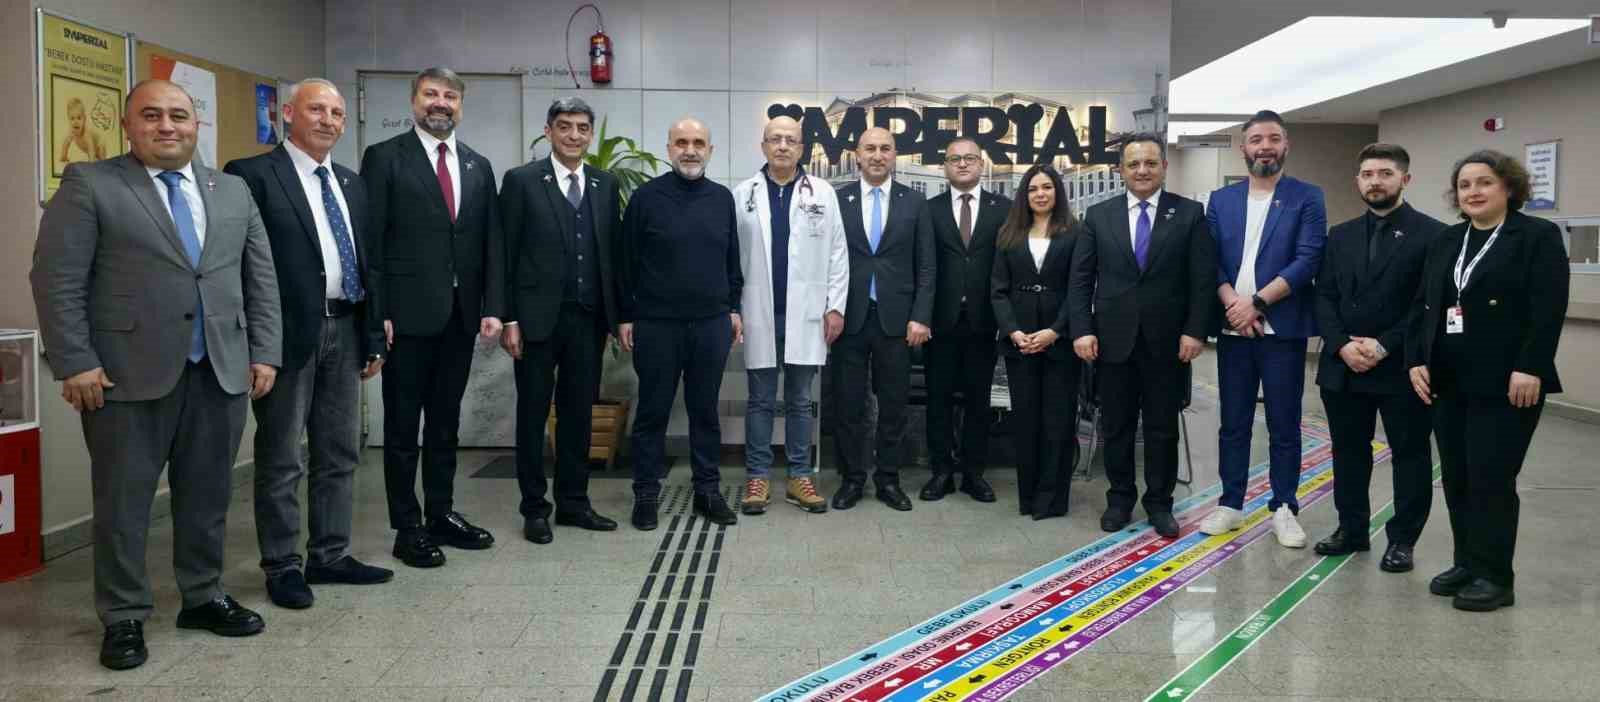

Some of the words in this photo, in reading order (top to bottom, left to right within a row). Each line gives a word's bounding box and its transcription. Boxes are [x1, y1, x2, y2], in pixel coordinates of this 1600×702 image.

[917, 618, 952, 635] GEBE
[992, 637, 1051, 669] RÖNTGEN
[854, 662, 898, 685] BEBEK
[914, 656, 943, 671] MR
